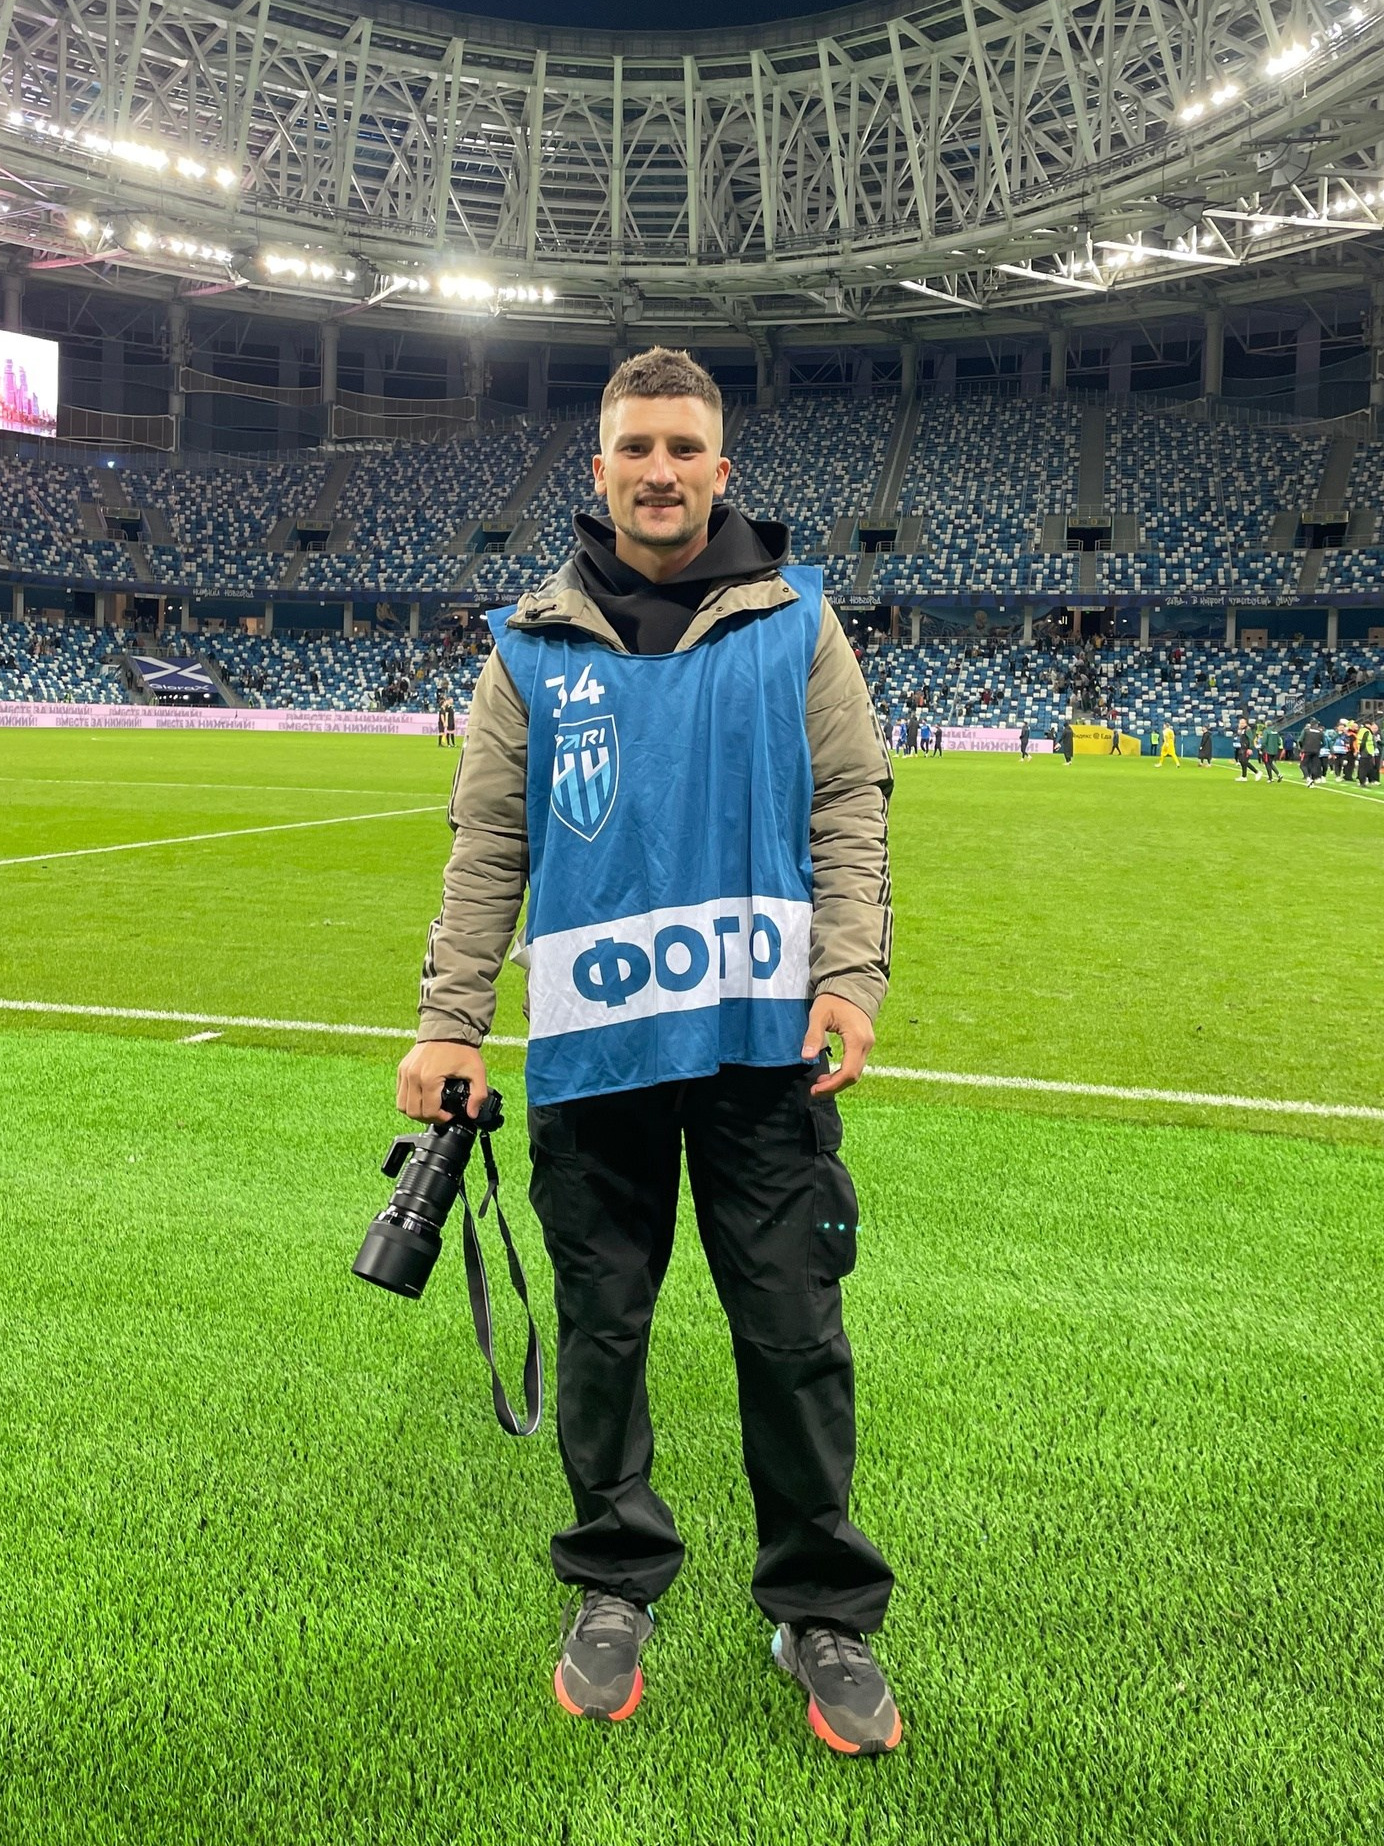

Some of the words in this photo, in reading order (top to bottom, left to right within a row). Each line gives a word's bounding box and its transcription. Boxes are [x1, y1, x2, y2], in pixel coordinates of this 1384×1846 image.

[0, 703, 31, 714] МЕСТЕ
[545, 663, 605, 718] 34
[572, 913, 782, 1008] ФОТО
